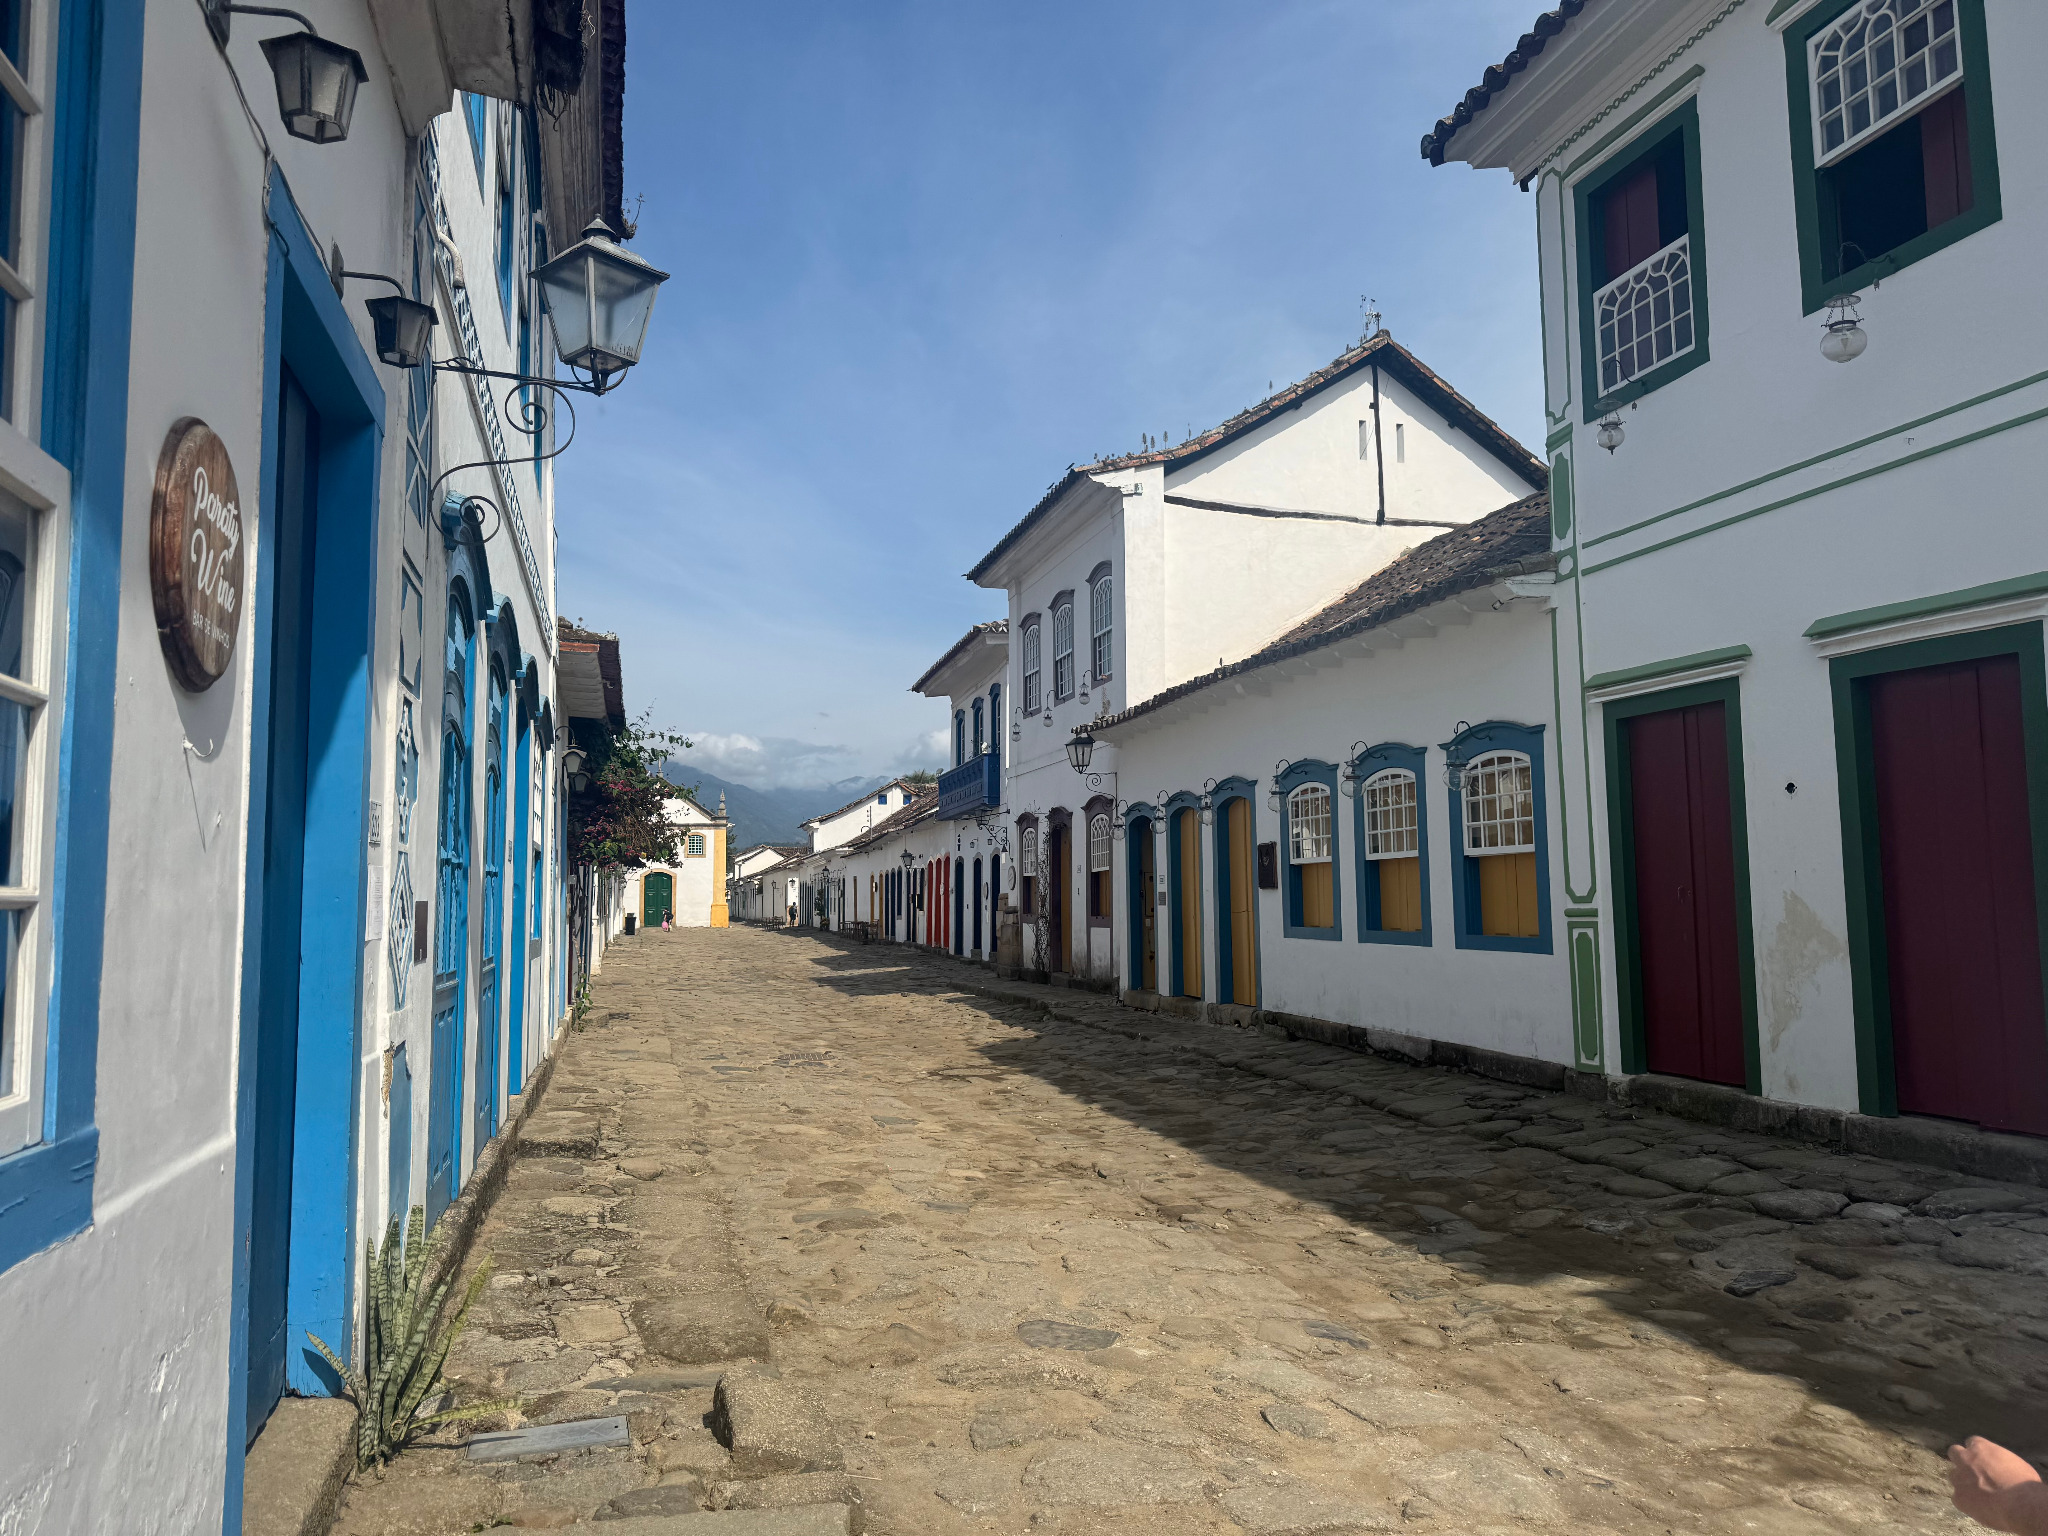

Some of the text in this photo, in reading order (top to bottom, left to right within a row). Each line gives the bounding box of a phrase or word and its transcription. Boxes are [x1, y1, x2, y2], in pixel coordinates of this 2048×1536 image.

[193, 466, 239, 560] Paraty
[191, 528, 235, 613] Wine
[192, 609, 204, 630] BAR
